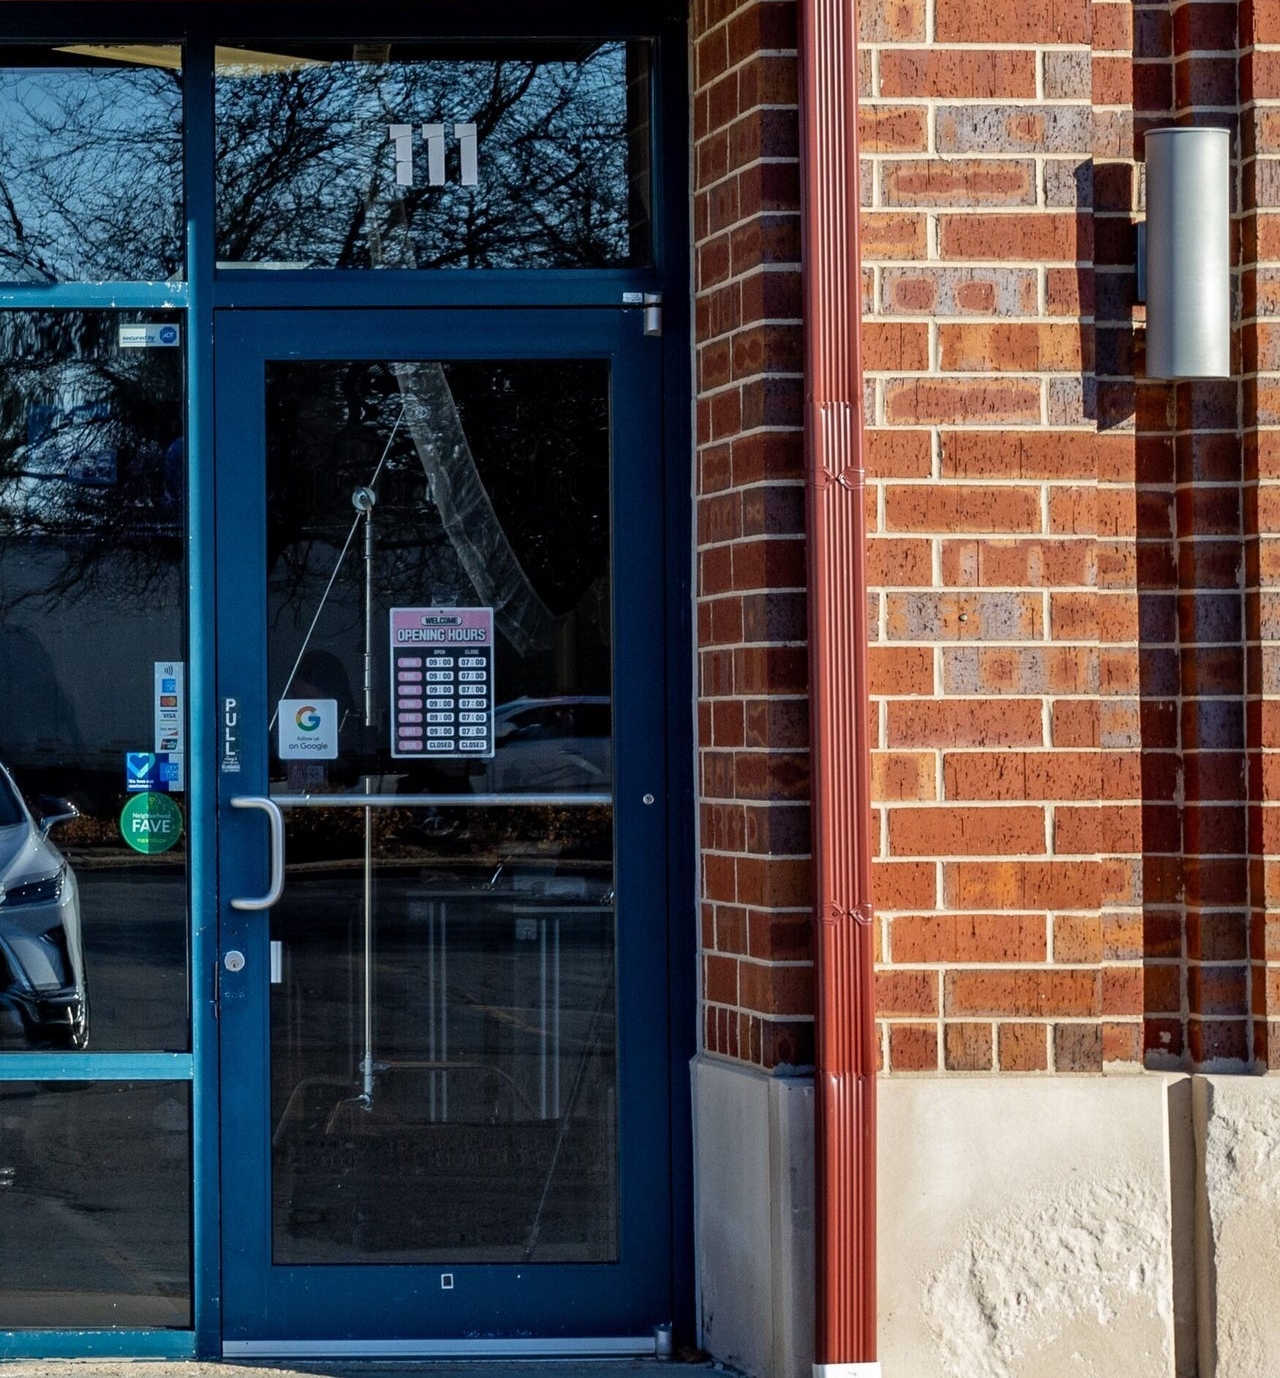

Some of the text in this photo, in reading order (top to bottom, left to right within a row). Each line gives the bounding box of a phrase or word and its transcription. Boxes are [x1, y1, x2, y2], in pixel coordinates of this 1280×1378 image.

[388, 123, 478, 186] 111
[425, 616, 459, 624] WELCOME
[397, 629, 486, 642] OPENING HOURS
[225, 698, 237, 756] PULL
[300, 742, 328, 751] Google
[132, 812, 171, 820] Neighborhood
[132, 819, 171, 833] FAVE
